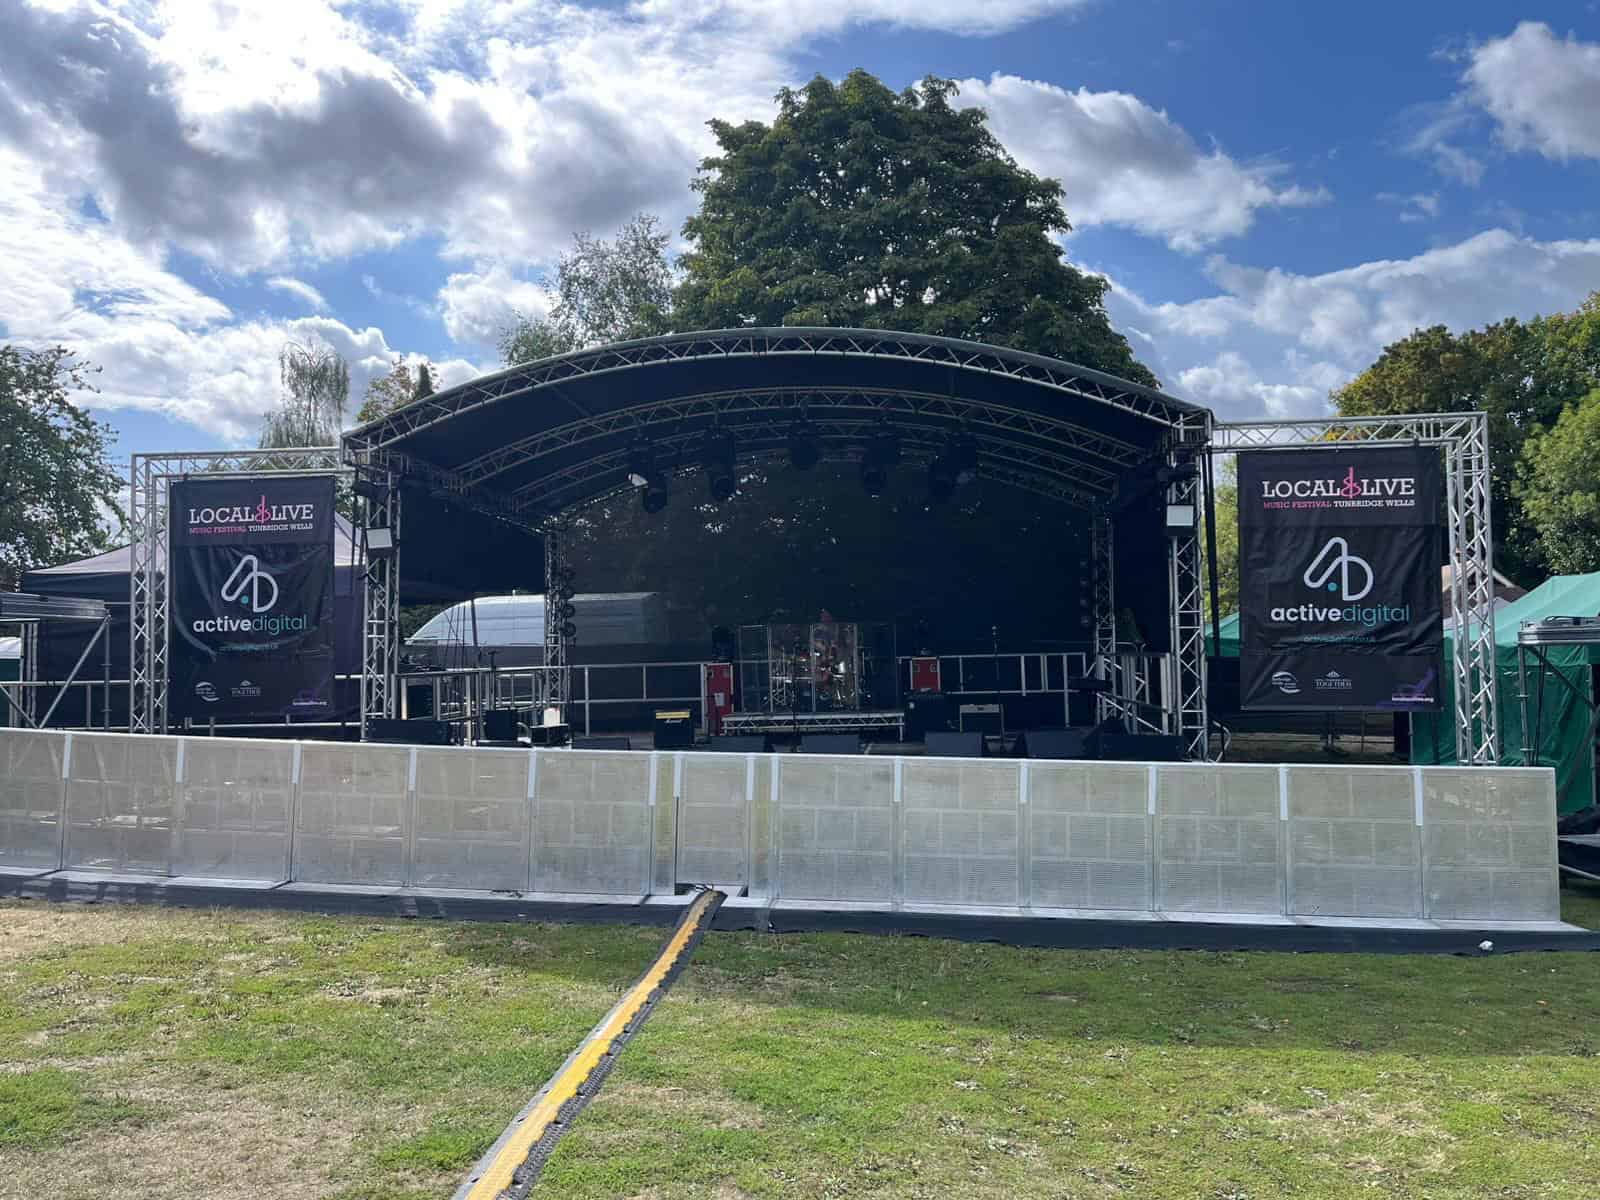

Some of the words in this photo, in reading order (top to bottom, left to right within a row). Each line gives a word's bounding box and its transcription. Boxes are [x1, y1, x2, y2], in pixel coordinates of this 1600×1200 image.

[1263, 501, 1290, 509] MUSIC
[1292, 501, 1331, 509] FESTIVAL
[1333, 500, 1384, 508] TUNBRIDGE
[1386, 499, 1415, 507] WELLS
[248, 524, 288, 532] TUNBRIDGE
